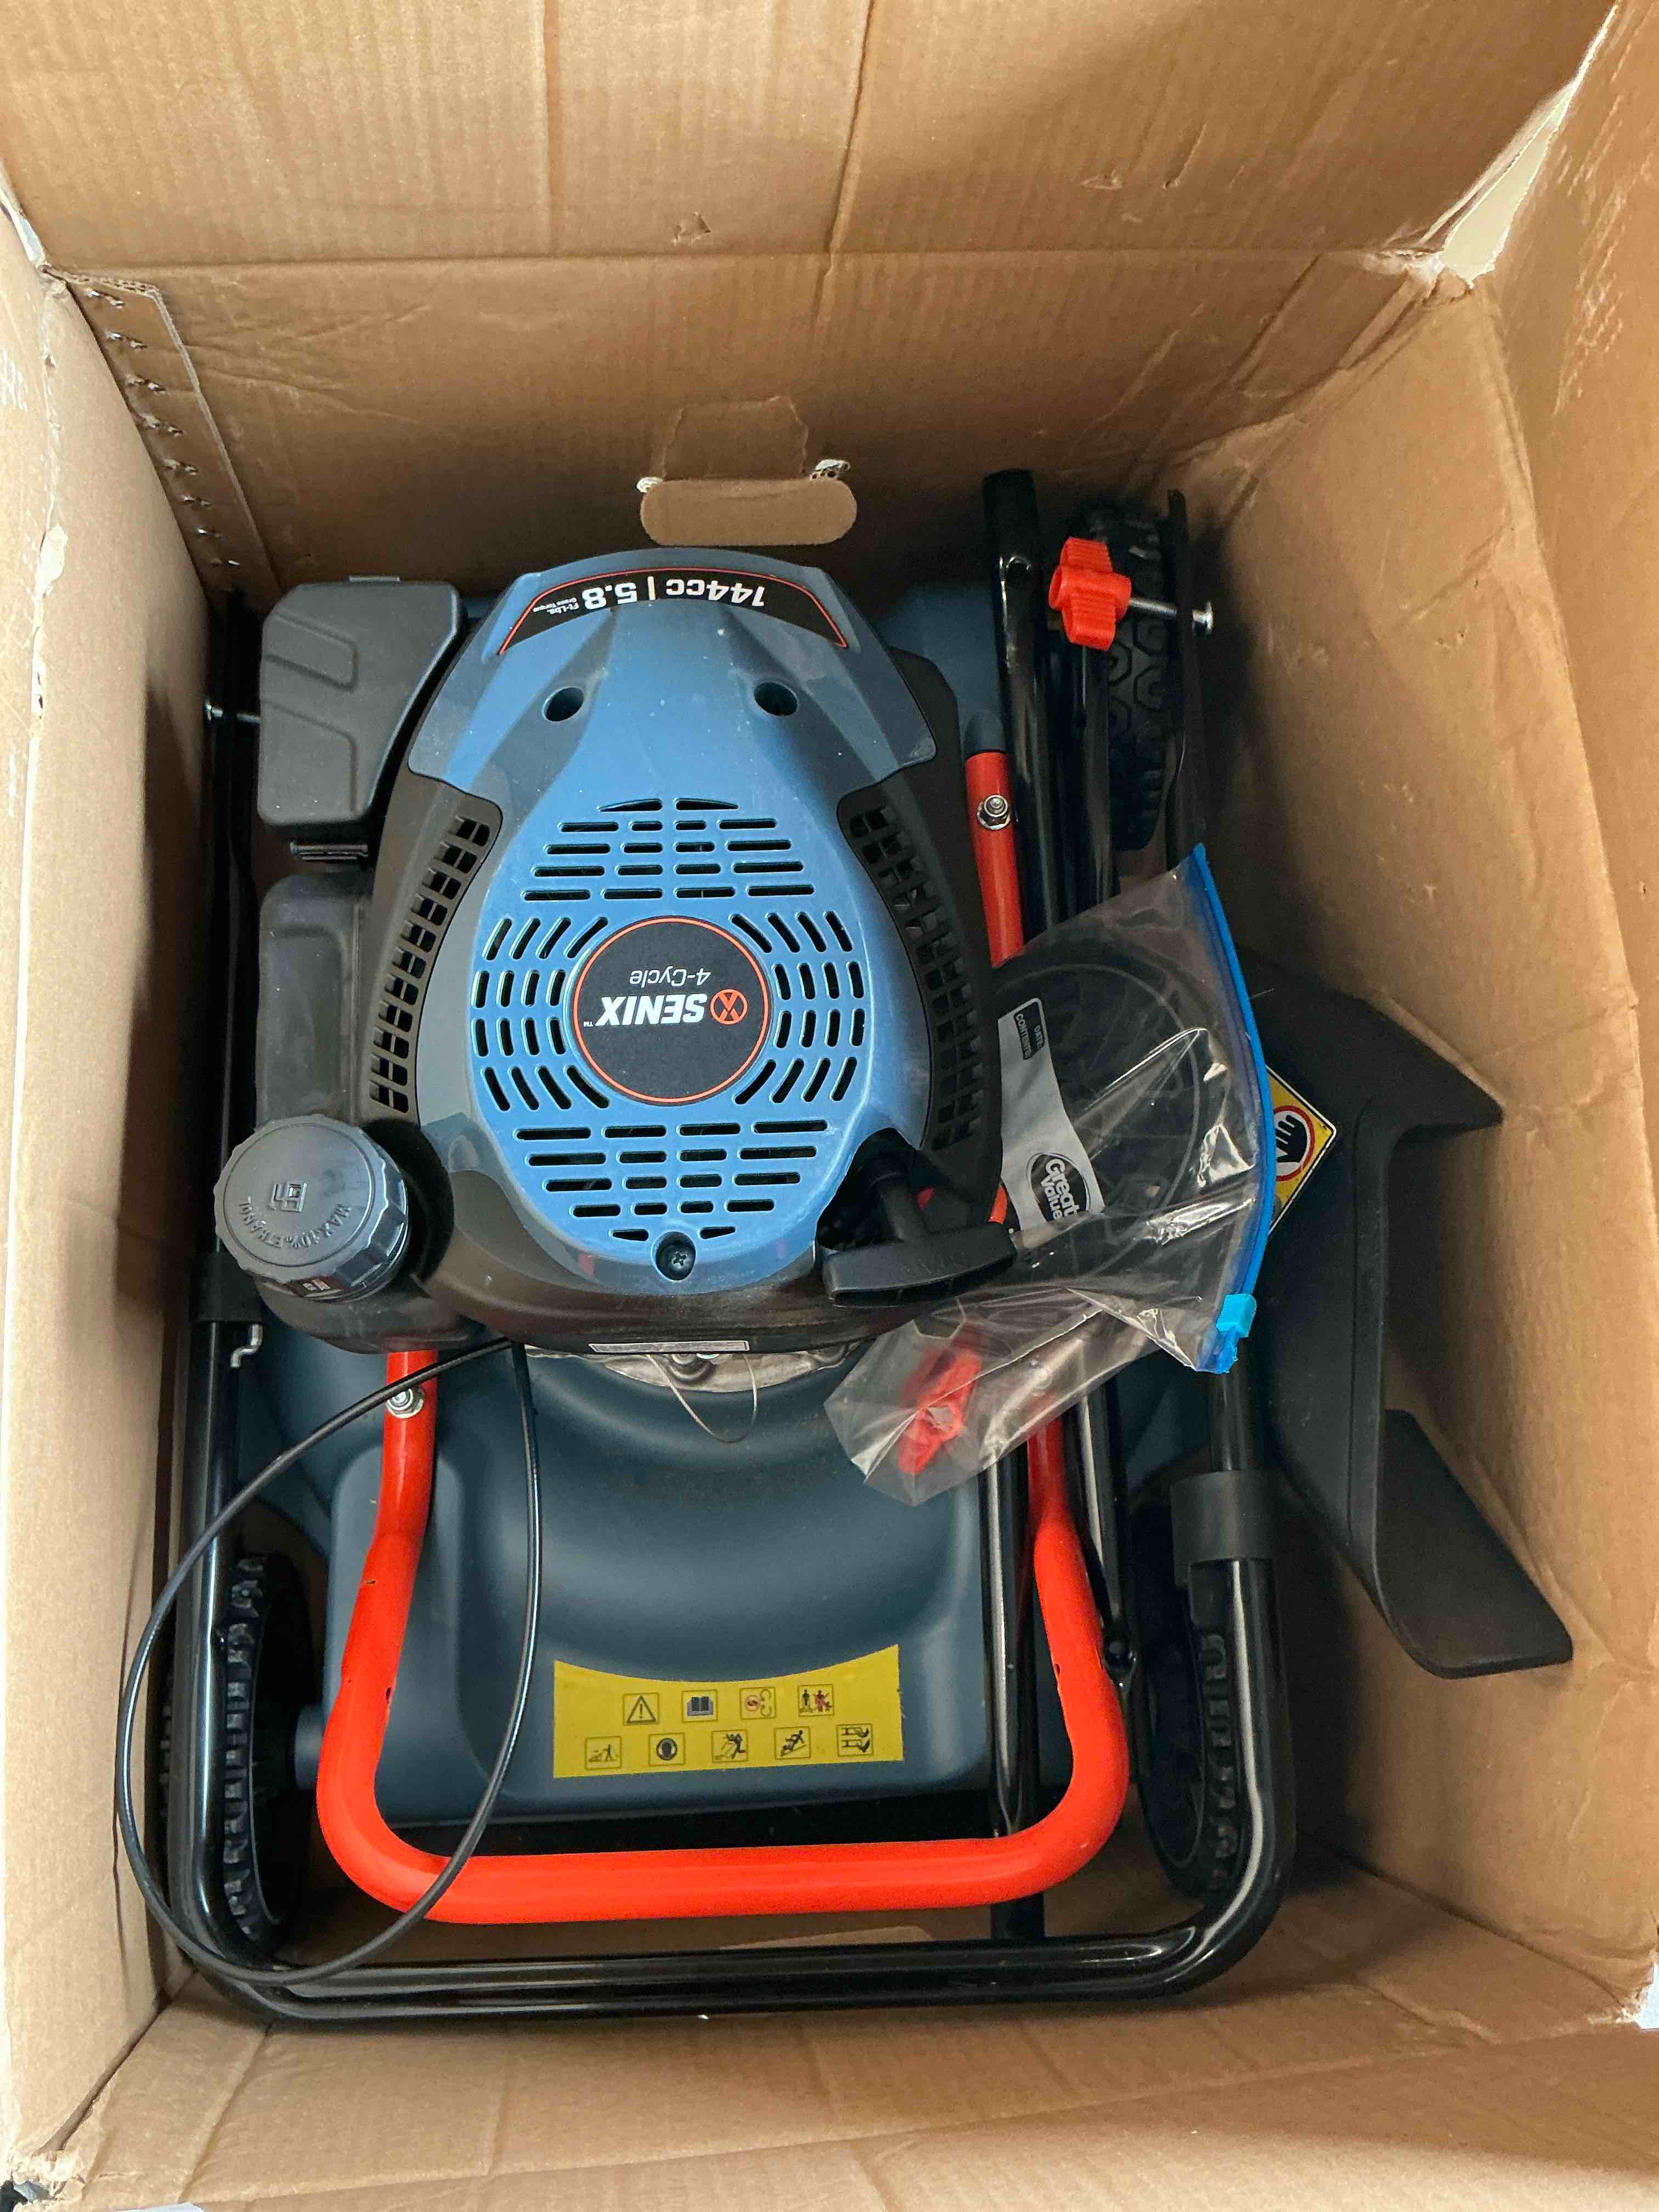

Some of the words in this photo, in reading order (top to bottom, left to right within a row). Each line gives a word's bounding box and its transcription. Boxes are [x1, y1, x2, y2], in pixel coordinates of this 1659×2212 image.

[582, 582, 637, 611] 5.8
[665, 579, 765, 607] 144cc
[629, 966, 712, 988] 4-Cycle
[1034, 1024, 1044, 1049] DATE
[1040, 1175, 1063, 1220] Value
[1045, 1158, 1080, 1216] Great
